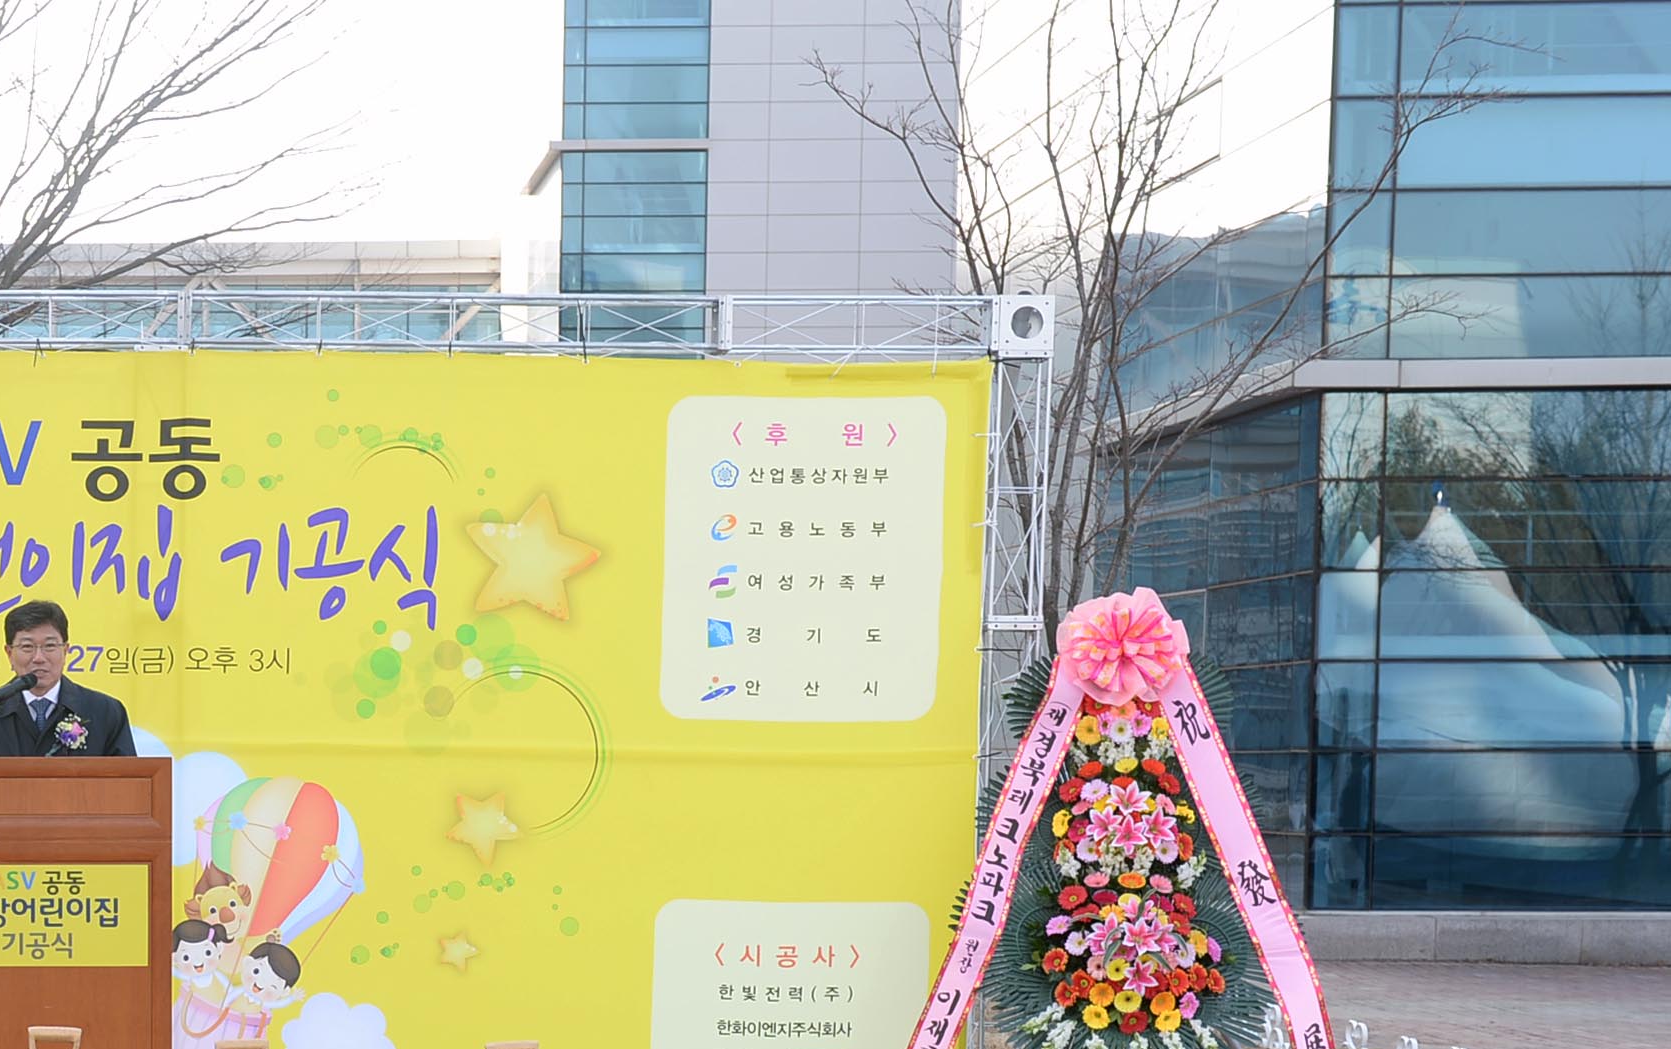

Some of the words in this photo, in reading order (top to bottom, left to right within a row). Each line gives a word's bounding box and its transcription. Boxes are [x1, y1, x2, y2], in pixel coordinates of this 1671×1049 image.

[70, 417, 221, 502] 공동
[747, 466, 890, 486] 산업통상자원부
[219, 504, 441, 632] 기공식
[184, 646, 239, 674] 오후
[248, 647, 291, 674] 3시
[41, 870, 86, 896] 공동
[1, 931, 74, 960] 기공식
[716, 1019, 853, 1039] 한화이엔지주식회사
